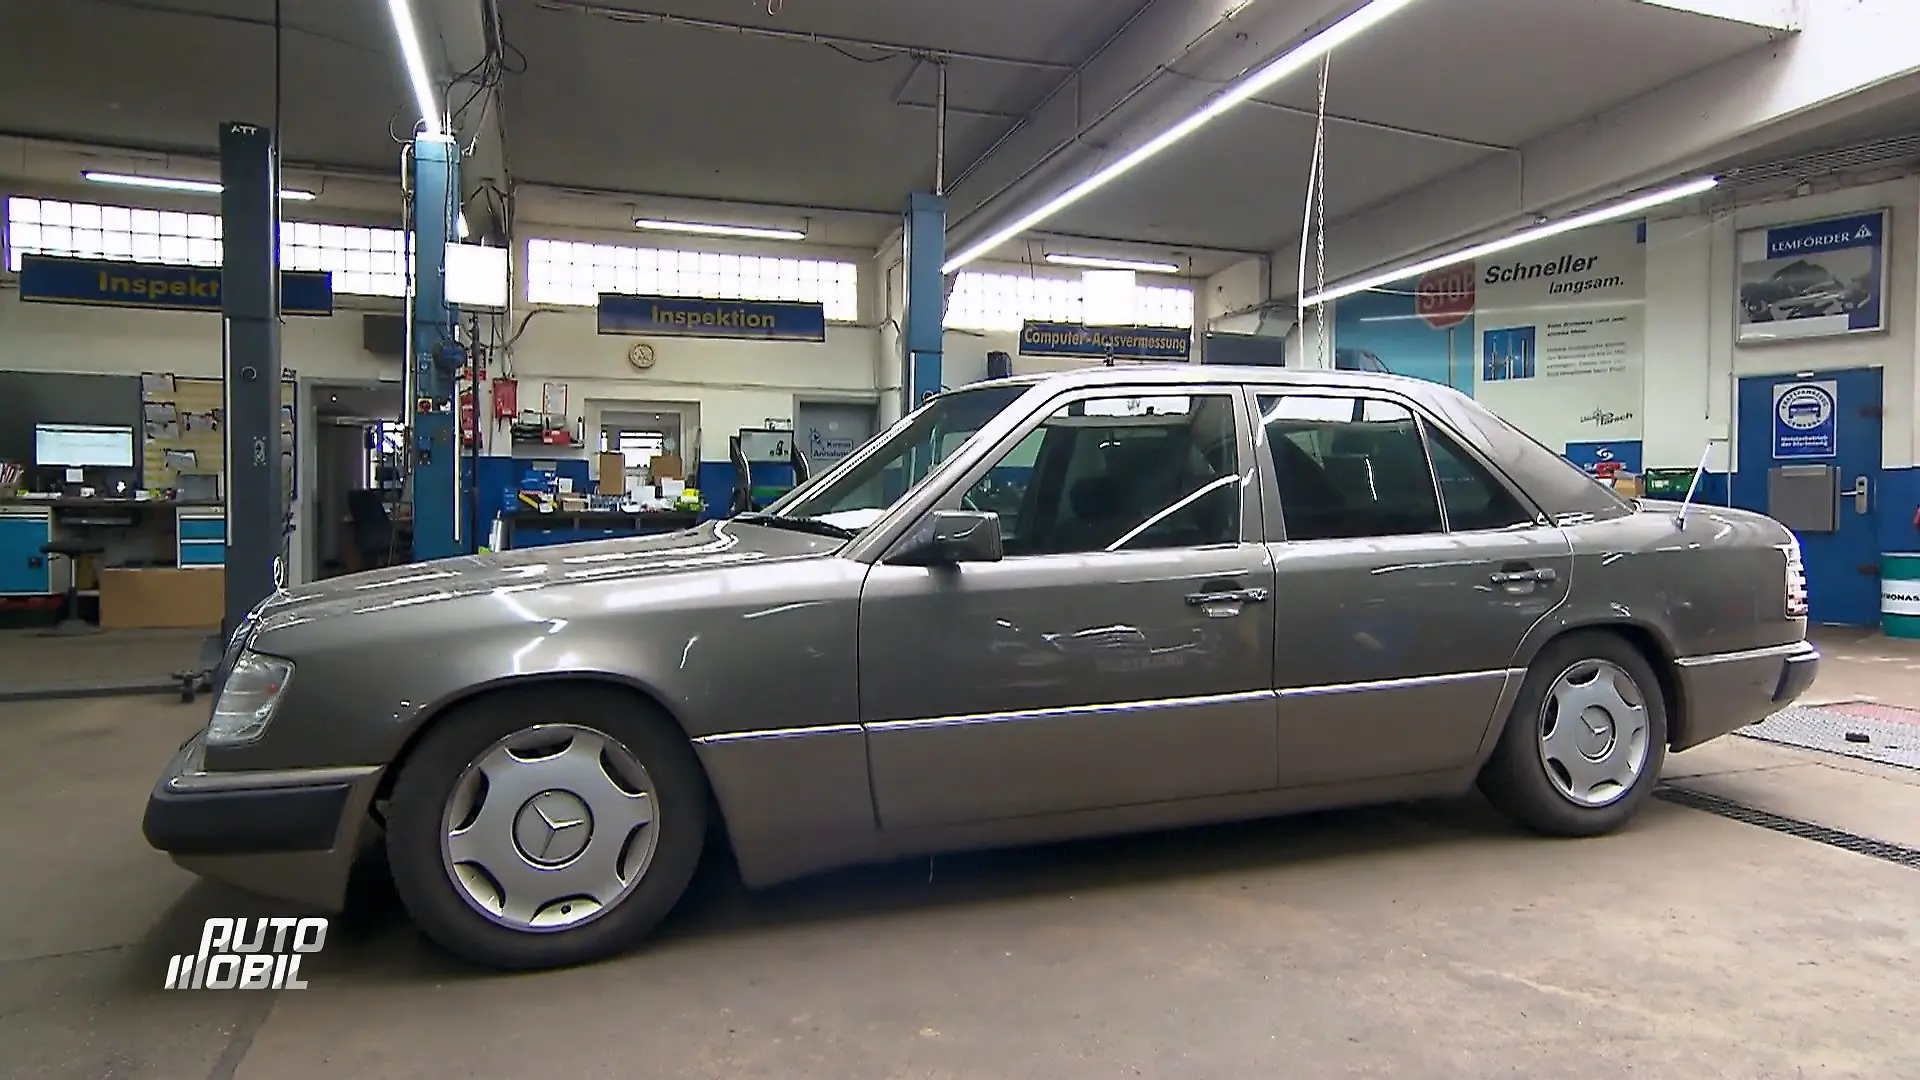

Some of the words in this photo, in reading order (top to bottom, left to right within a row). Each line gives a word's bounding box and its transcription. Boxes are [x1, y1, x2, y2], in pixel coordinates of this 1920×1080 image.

[1772, 231, 1849, 251] LEMFÖRDER
[1485, 254, 1598, 284] Schneller
[99, 270, 220, 299] Inspekt
[1549, 275, 1625, 295] langsam.
[652, 305, 775, 328] Inspektion
